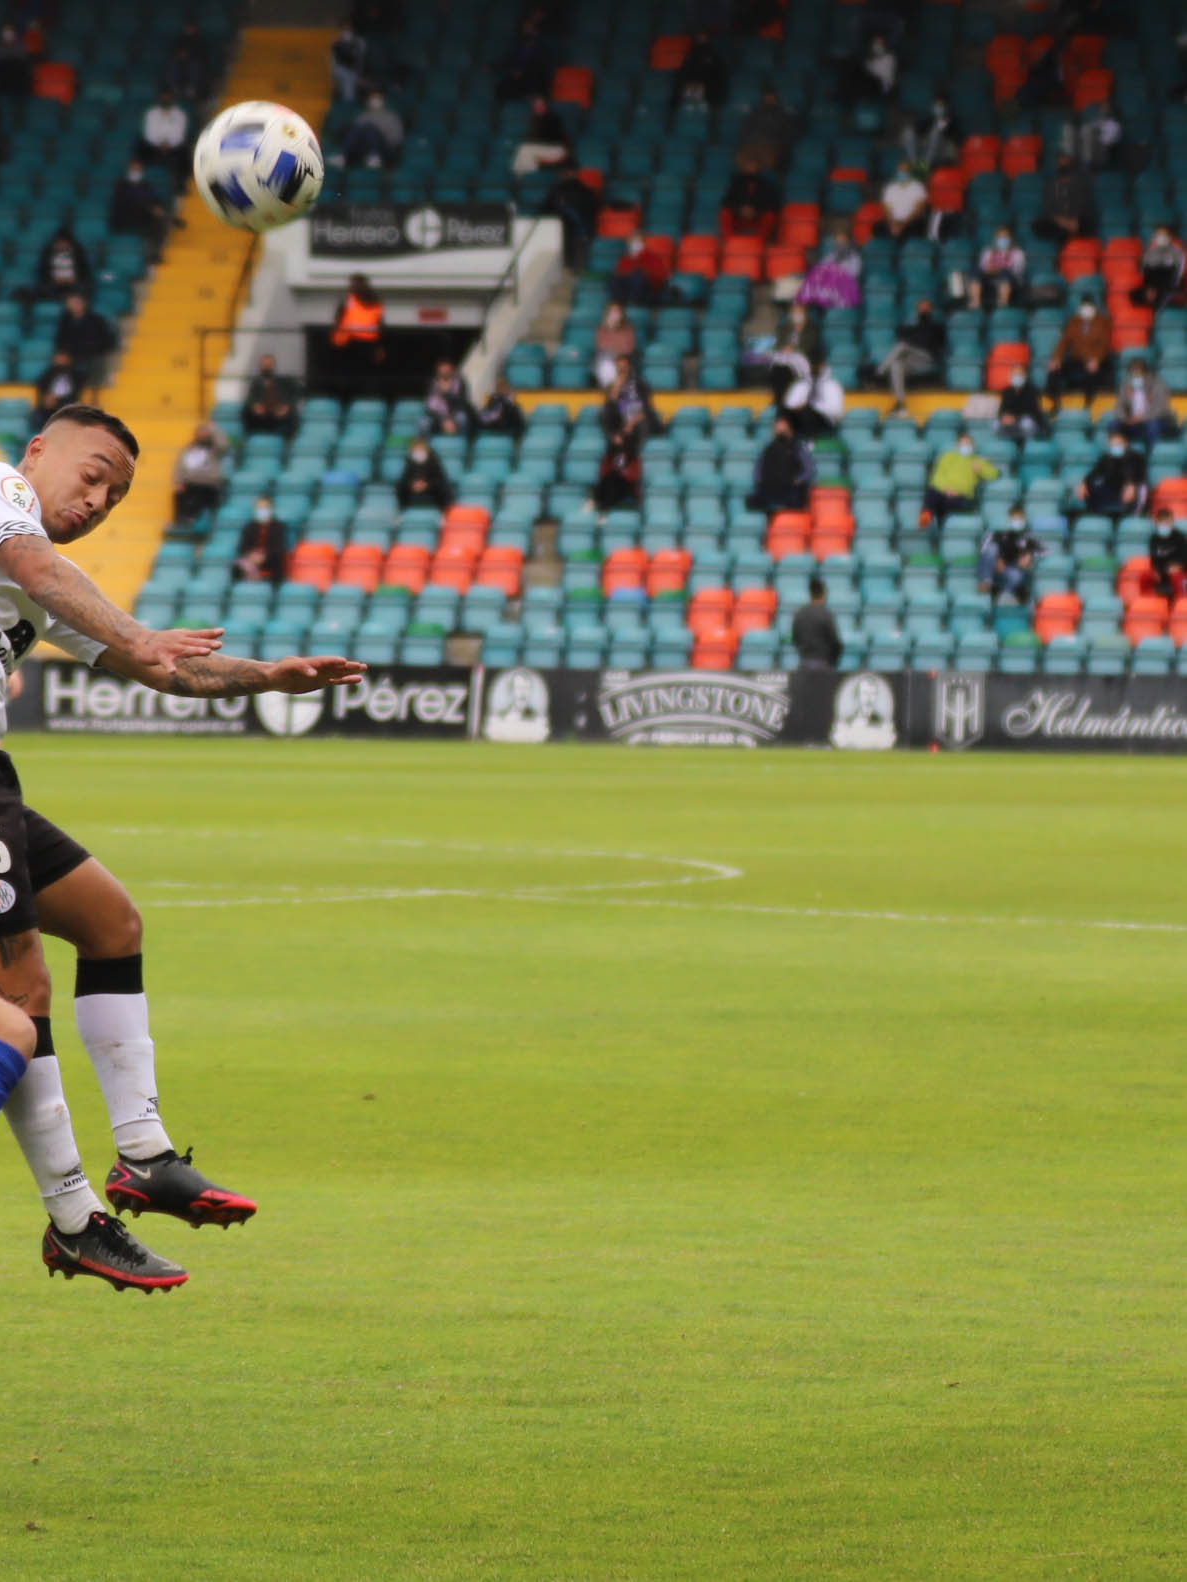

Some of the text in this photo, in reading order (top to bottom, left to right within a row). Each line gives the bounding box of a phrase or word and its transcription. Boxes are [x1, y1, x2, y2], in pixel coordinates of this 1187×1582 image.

[314, 217, 505, 244] Herrero Pérez
[333, 673, 468, 723] Pérez
[599, 686, 789, 732] LIVINGSTONE
[1002, 688, 1187, 737] Helmántic
